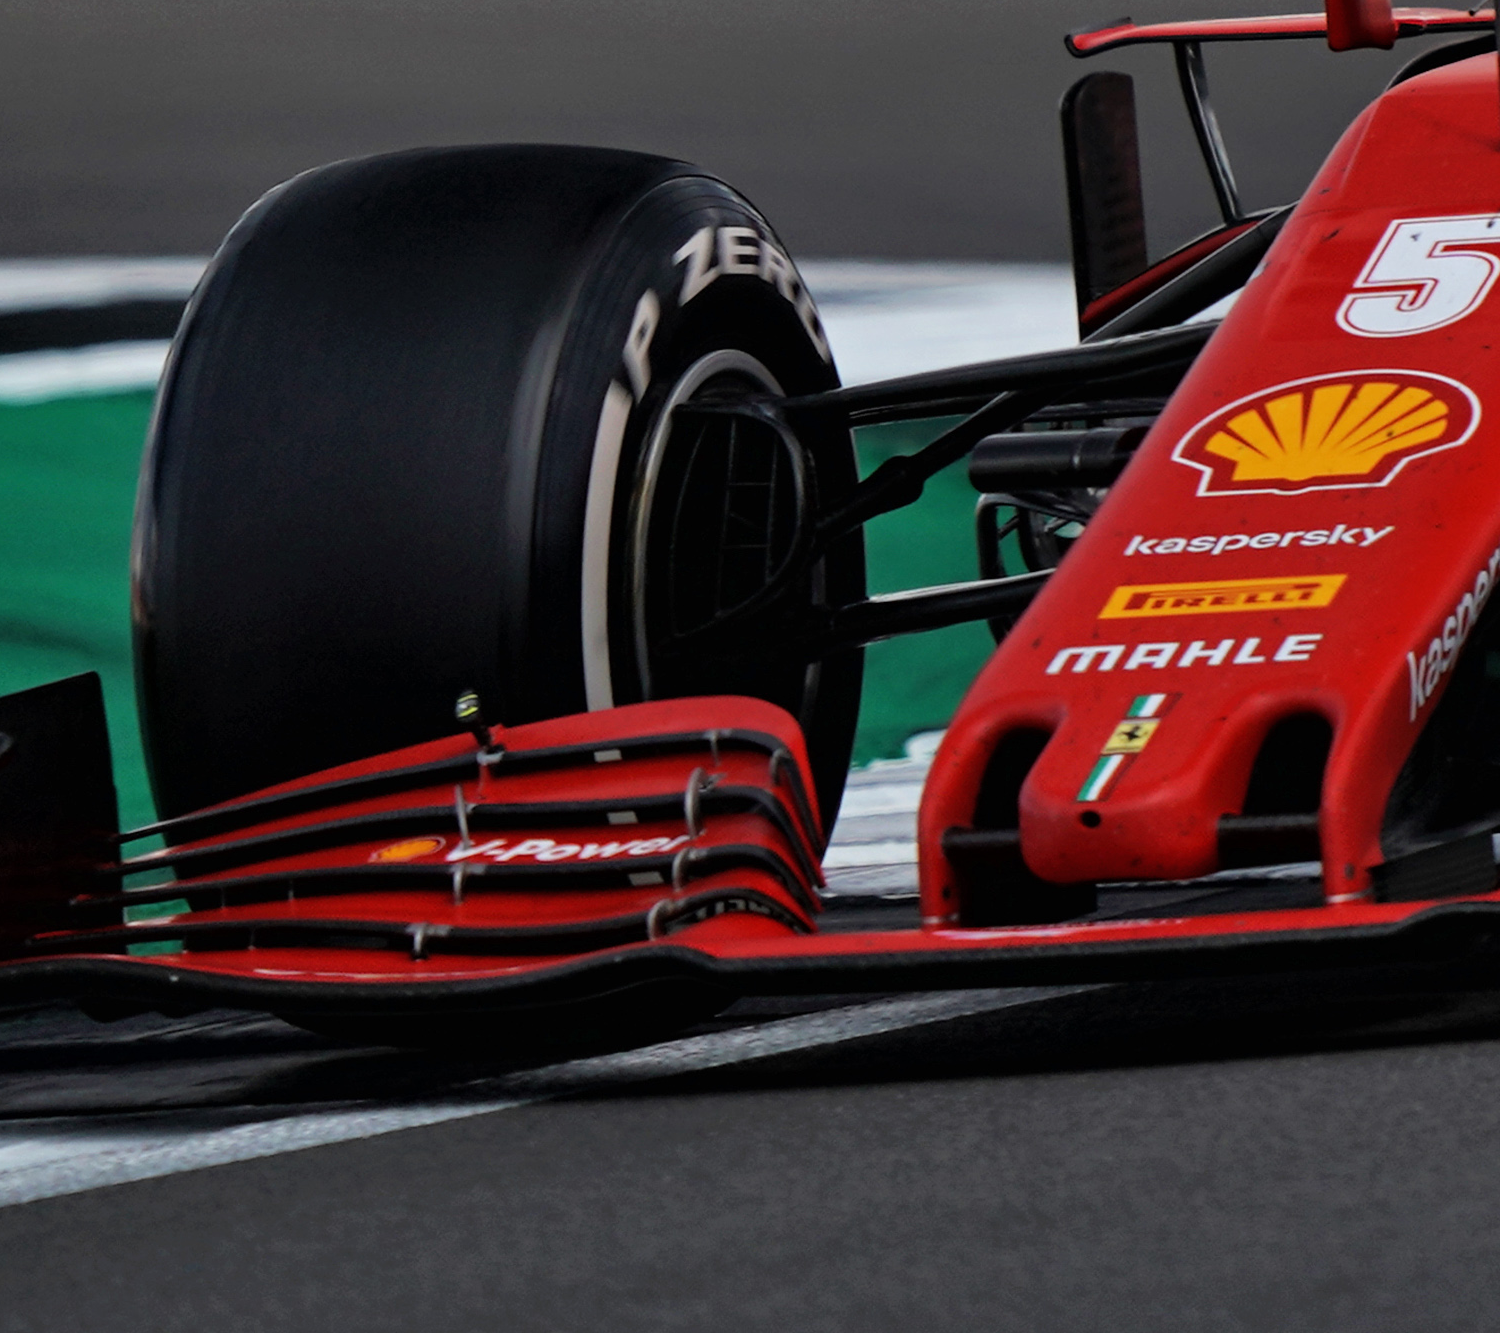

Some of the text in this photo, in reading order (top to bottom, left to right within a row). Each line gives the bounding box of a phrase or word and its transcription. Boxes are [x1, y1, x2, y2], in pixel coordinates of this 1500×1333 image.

[622, 286, 661, 405] P
[1123, 524, 1396, 556] kaspersky
[1121, 582, 1325, 612] PIRELLI
[1045, 633, 1324, 675] MAHLE
[445, 833, 700, 862] V-Power
